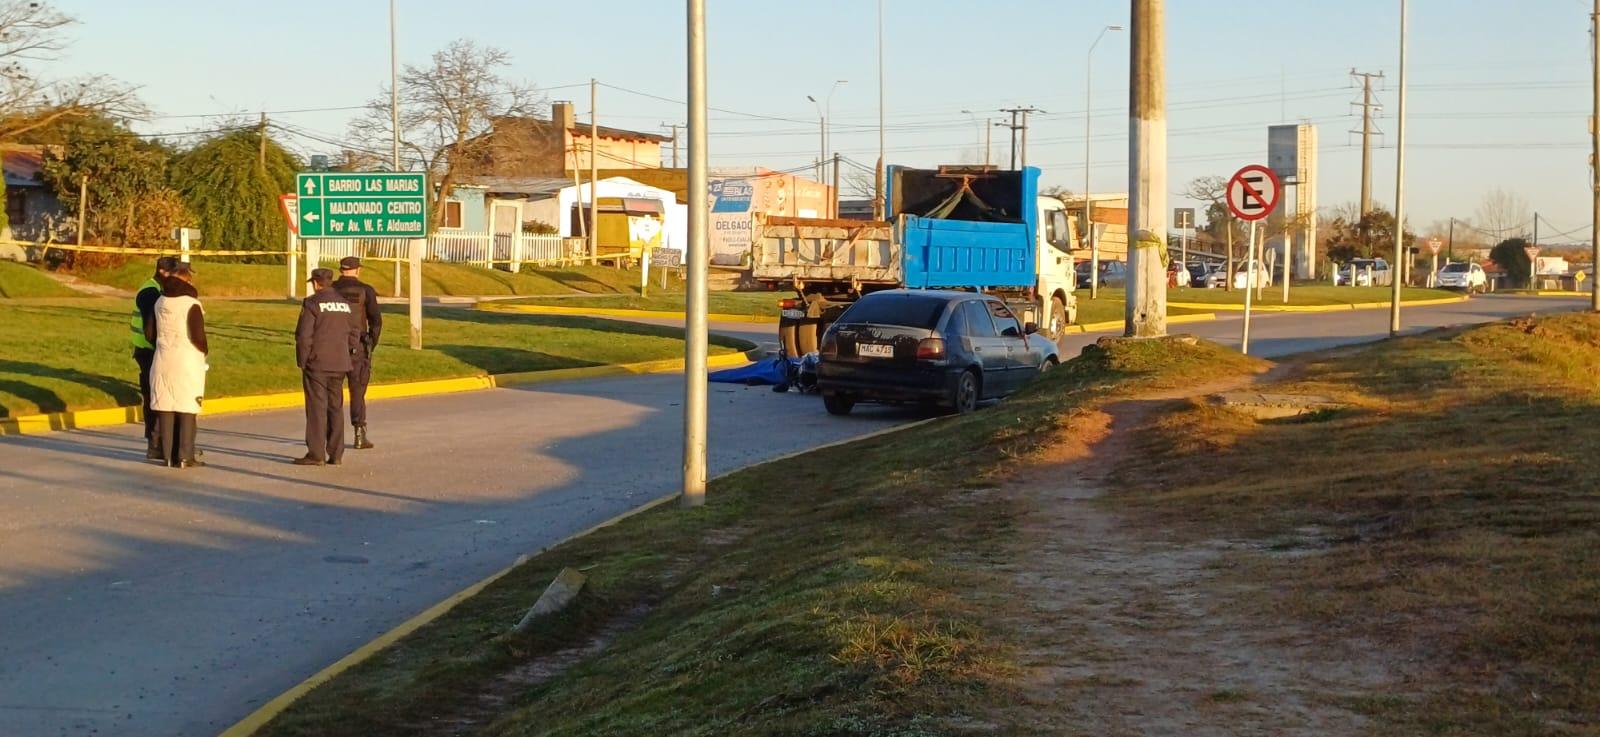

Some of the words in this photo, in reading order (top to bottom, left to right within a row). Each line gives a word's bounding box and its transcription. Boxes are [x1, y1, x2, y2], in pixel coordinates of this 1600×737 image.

[329, 179, 361, 192] BARRIO
[365, 179, 382, 192] LAS
[387, 179, 419, 192] MARIAS
[1242, 176, 1264, 209] E
[330, 202, 383, 214] MALDONADO
[388, 202, 421, 214] CENTRO
[330, 219, 344, 231] Por
[348, 219, 360, 231] Av.
[364, 219, 373, 231] W.
[377, 219, 383, 231] F.
[387, 219, 421, 231] Aldunate
[716, 221, 752, 230] DELGADO
